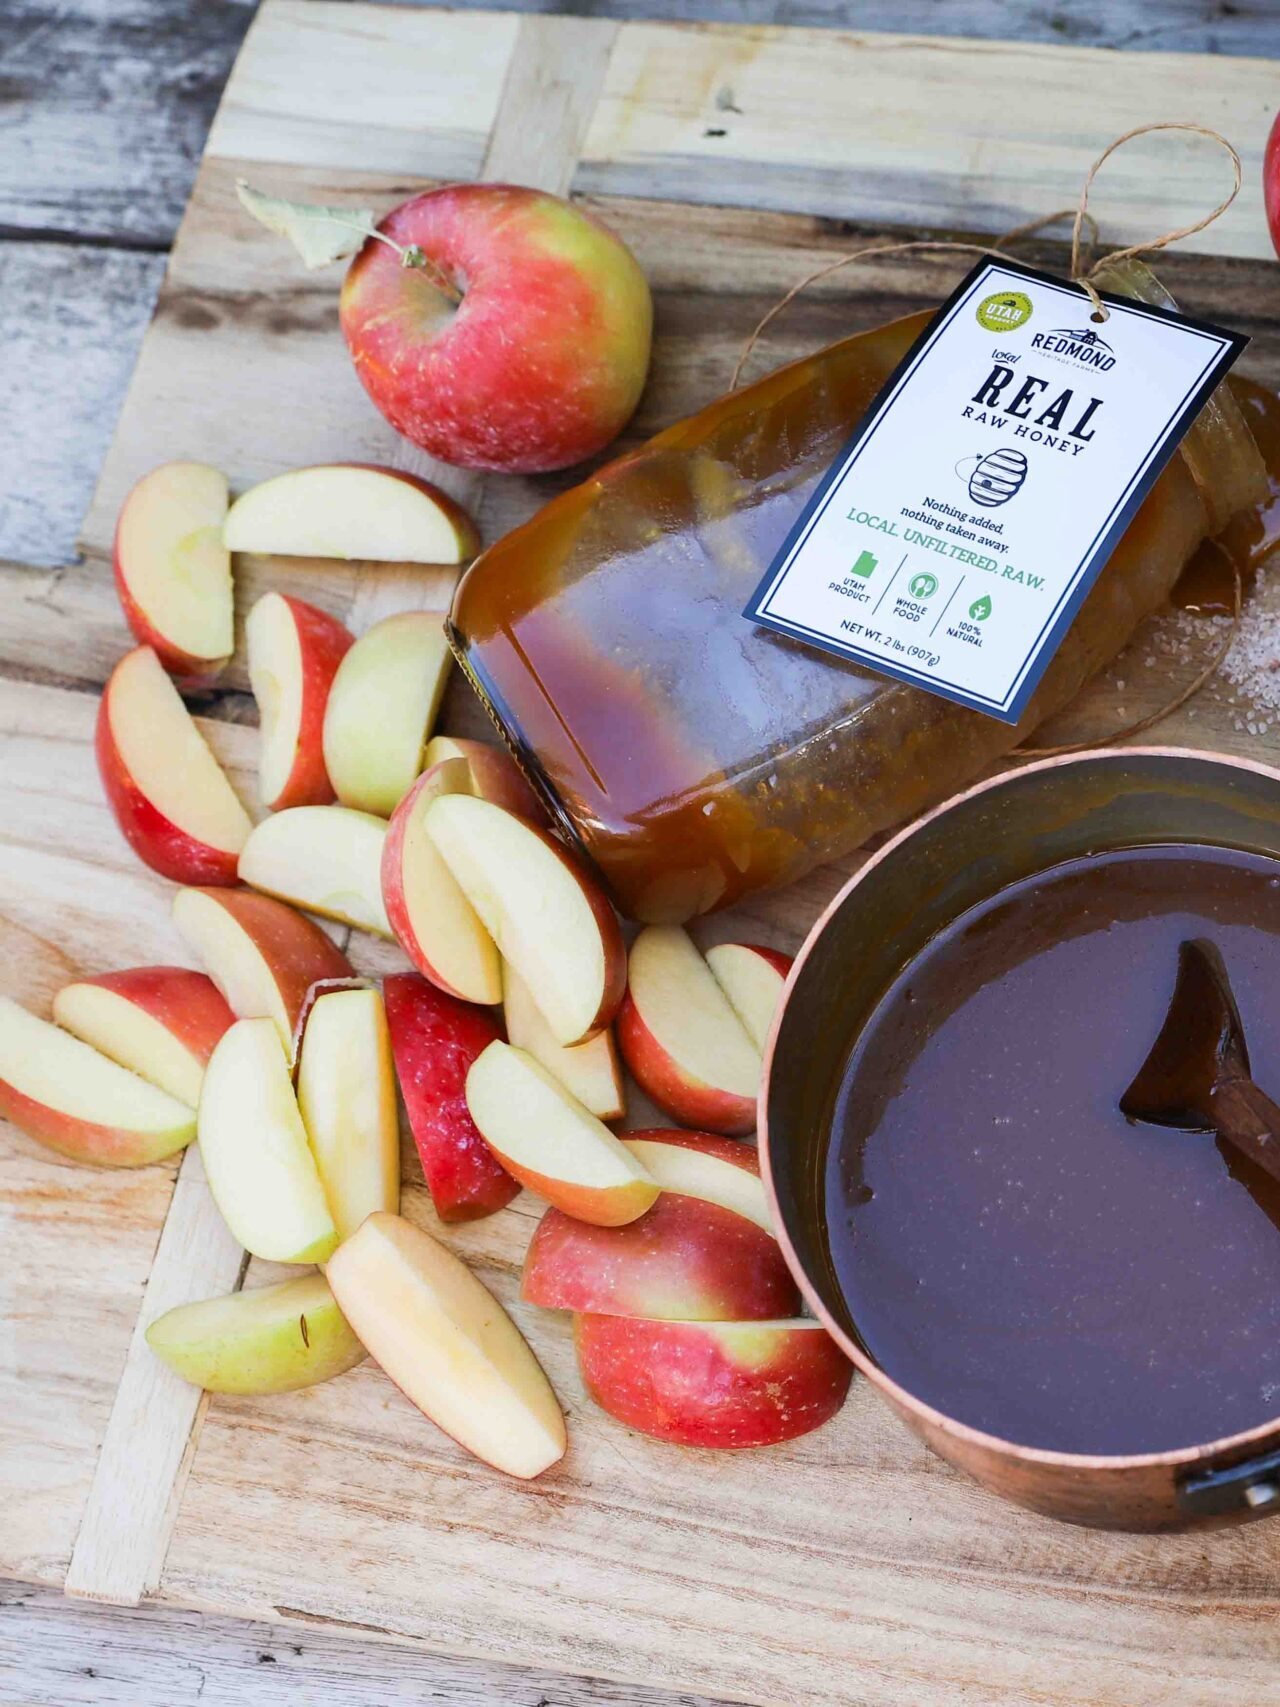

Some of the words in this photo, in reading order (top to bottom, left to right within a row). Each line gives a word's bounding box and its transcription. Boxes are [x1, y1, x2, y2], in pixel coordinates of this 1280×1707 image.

[986, 303, 1023, 321] UTAH
[1030, 333, 1116, 372] REDMOND
[1038, 351, 1070, 365] HERITAGE
[970, 364, 1104, 442] REAL
[961, 406, 1009, 429] RAW
[1013, 424, 1085, 456] HONEY
[922, 496, 967, 523] Nothing
[968, 513, 1004, 536] added,
[899, 506, 945, 531] nothing
[945, 523, 977, 543] taken
[977, 535, 1010, 554] away.
[846, 507, 899, 537] LOCAL.
[903, 528, 999, 575] UNFILTERED.
[1001, 564, 1046, 592] RAW.
[828, 582, 872, 604] PRODUCT
[843, 577, 867, 592] UTAH
[893, 607, 921, 623] FOOD
[896, 597, 928, 615] WHOLE
[946, 628, 983, 648] NATURAL
[958, 621, 982, 636] 100%
[840, 619, 863, 635] NET
[865, 627, 882, 644] WT.
[883, 636, 893, 647] 2
[892, 639, 905, 652] lbs
[906, 645, 941, 667] (907g)
